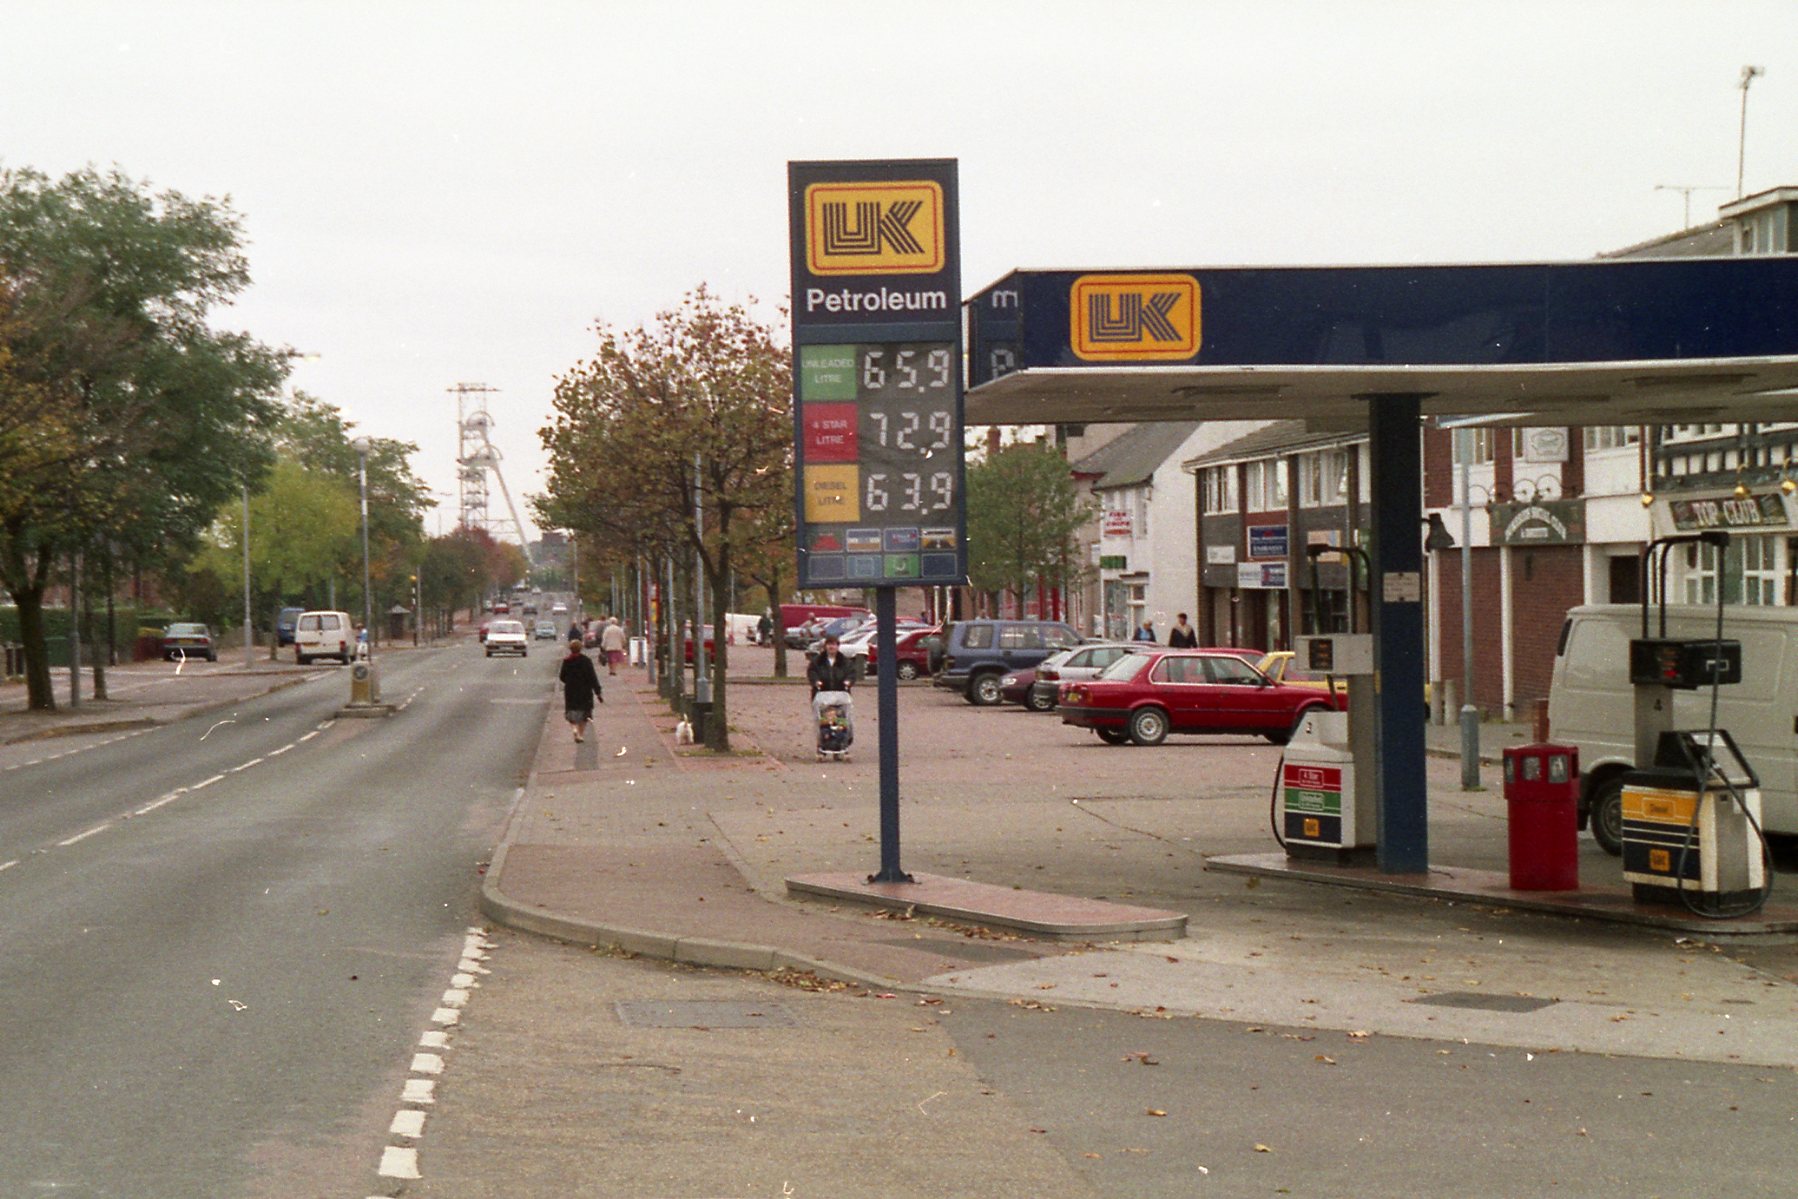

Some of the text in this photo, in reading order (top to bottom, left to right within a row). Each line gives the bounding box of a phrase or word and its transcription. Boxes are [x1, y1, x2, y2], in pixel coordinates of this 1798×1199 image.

[823, 200, 925, 255] UK
[806, 287, 947, 312] Petroleum
[1089, 292, 1183, 342] UK
[801, 358, 855, 368] UNLEADED
[814, 373, 843, 384] LITRE
[822, 419, 848, 429] STAR
[815, 434, 844, 445] LITRE
[814, 480, 847, 490] DIESEL
